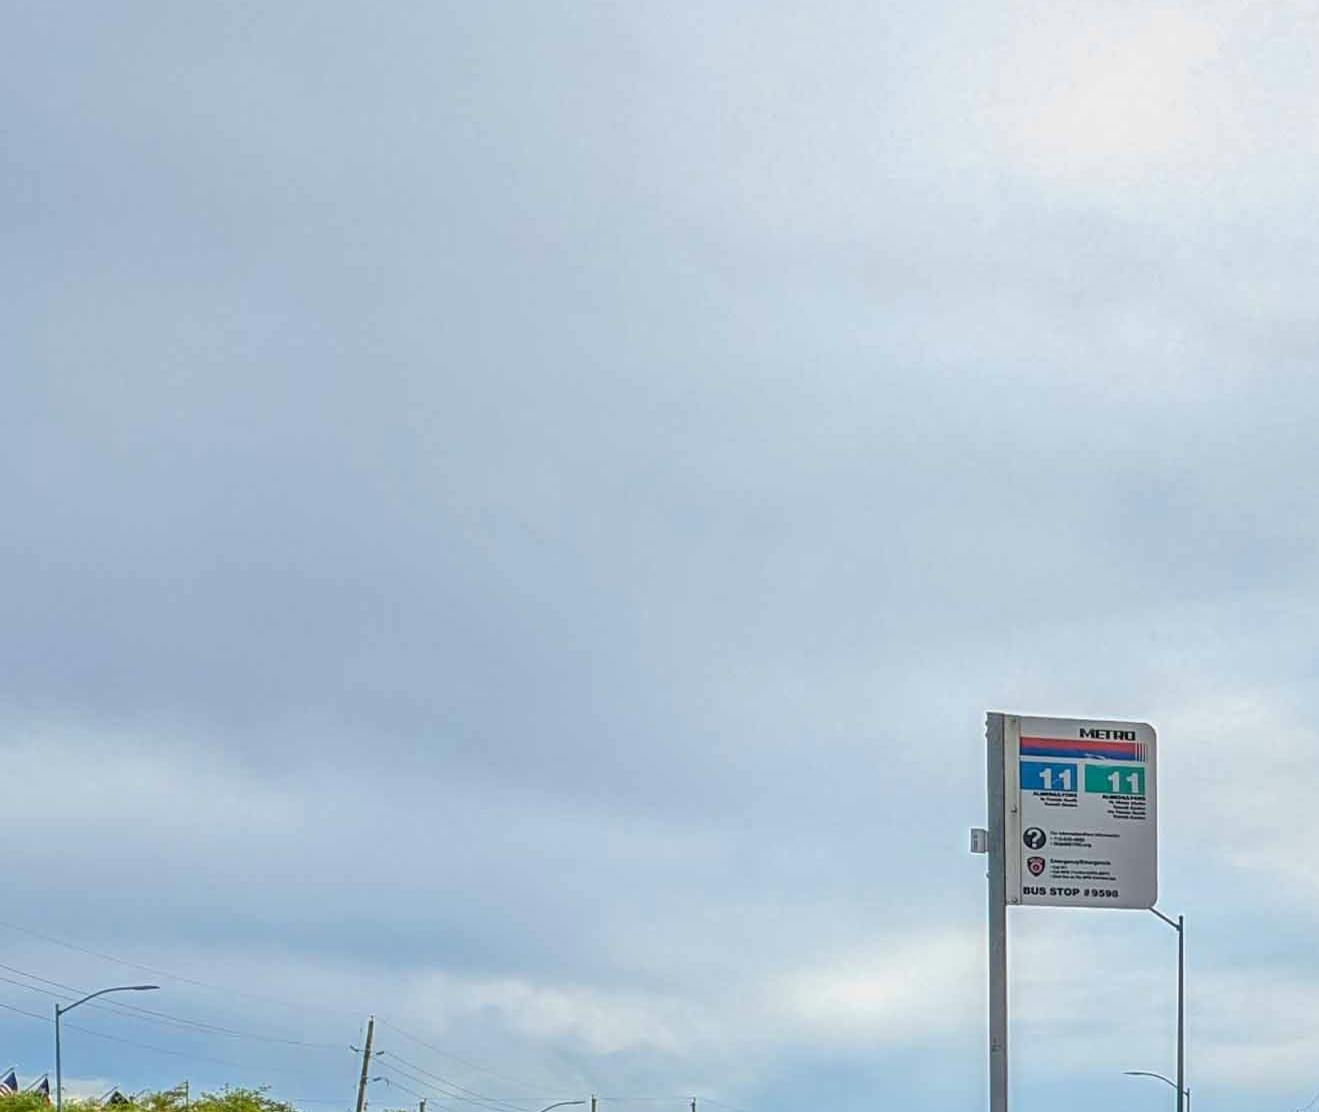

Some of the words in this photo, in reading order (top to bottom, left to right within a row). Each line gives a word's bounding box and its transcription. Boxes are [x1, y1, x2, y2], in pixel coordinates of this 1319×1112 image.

[1079, 728, 1136, 741] METRO
[1039, 768, 1072, 790] 11
[1107, 771, 1139, 793] 11
[1023, 887, 1046, 895] BUS
[1050, 887, 1080, 896] STOP
